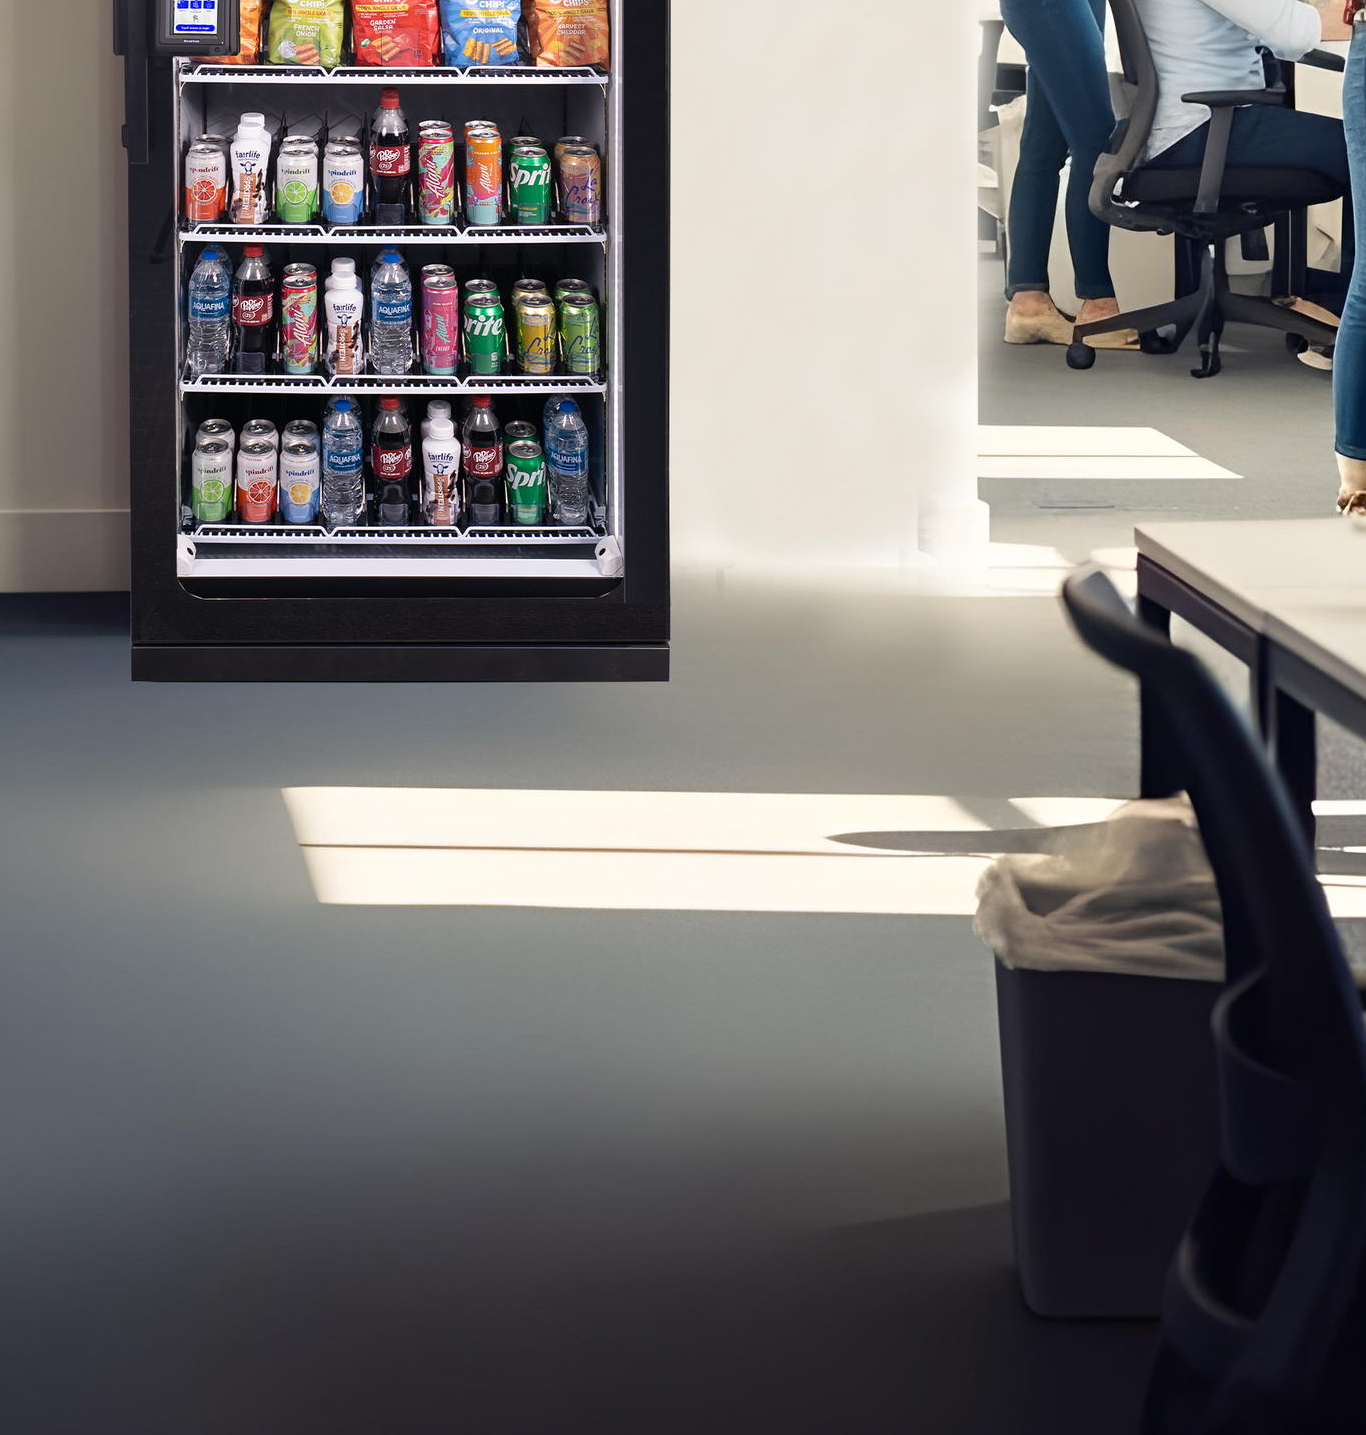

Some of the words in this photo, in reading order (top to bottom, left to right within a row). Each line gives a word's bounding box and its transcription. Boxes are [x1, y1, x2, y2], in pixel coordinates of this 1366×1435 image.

[299, 0, 328, 8] CHIPS
[479, 0, 506, 8] CHIPS
[370, 18, 397, 26] GARDEN
[293, 24, 320, 32] FRENCH
[281, 167, 311, 175] spindrift
[328, 169, 357, 177] spindrift
[581, 169, 598, 192] La
[242, 179, 251, 210] PROTEIN
[193, 301, 225, 312] AQUAFINA
[378, 305, 411, 315] AQUAFINA
[338, 332, 346, 362] PROTEIN
[329, 453, 361, 465] AQUAFINA
[551, 452, 583, 464] AQUAFINA
[197, 465, 227, 474] spindrift
[245, 465, 274, 476] spindrift
[285, 468, 315, 477] spindrift
[506, 461, 547, 490] Spri
